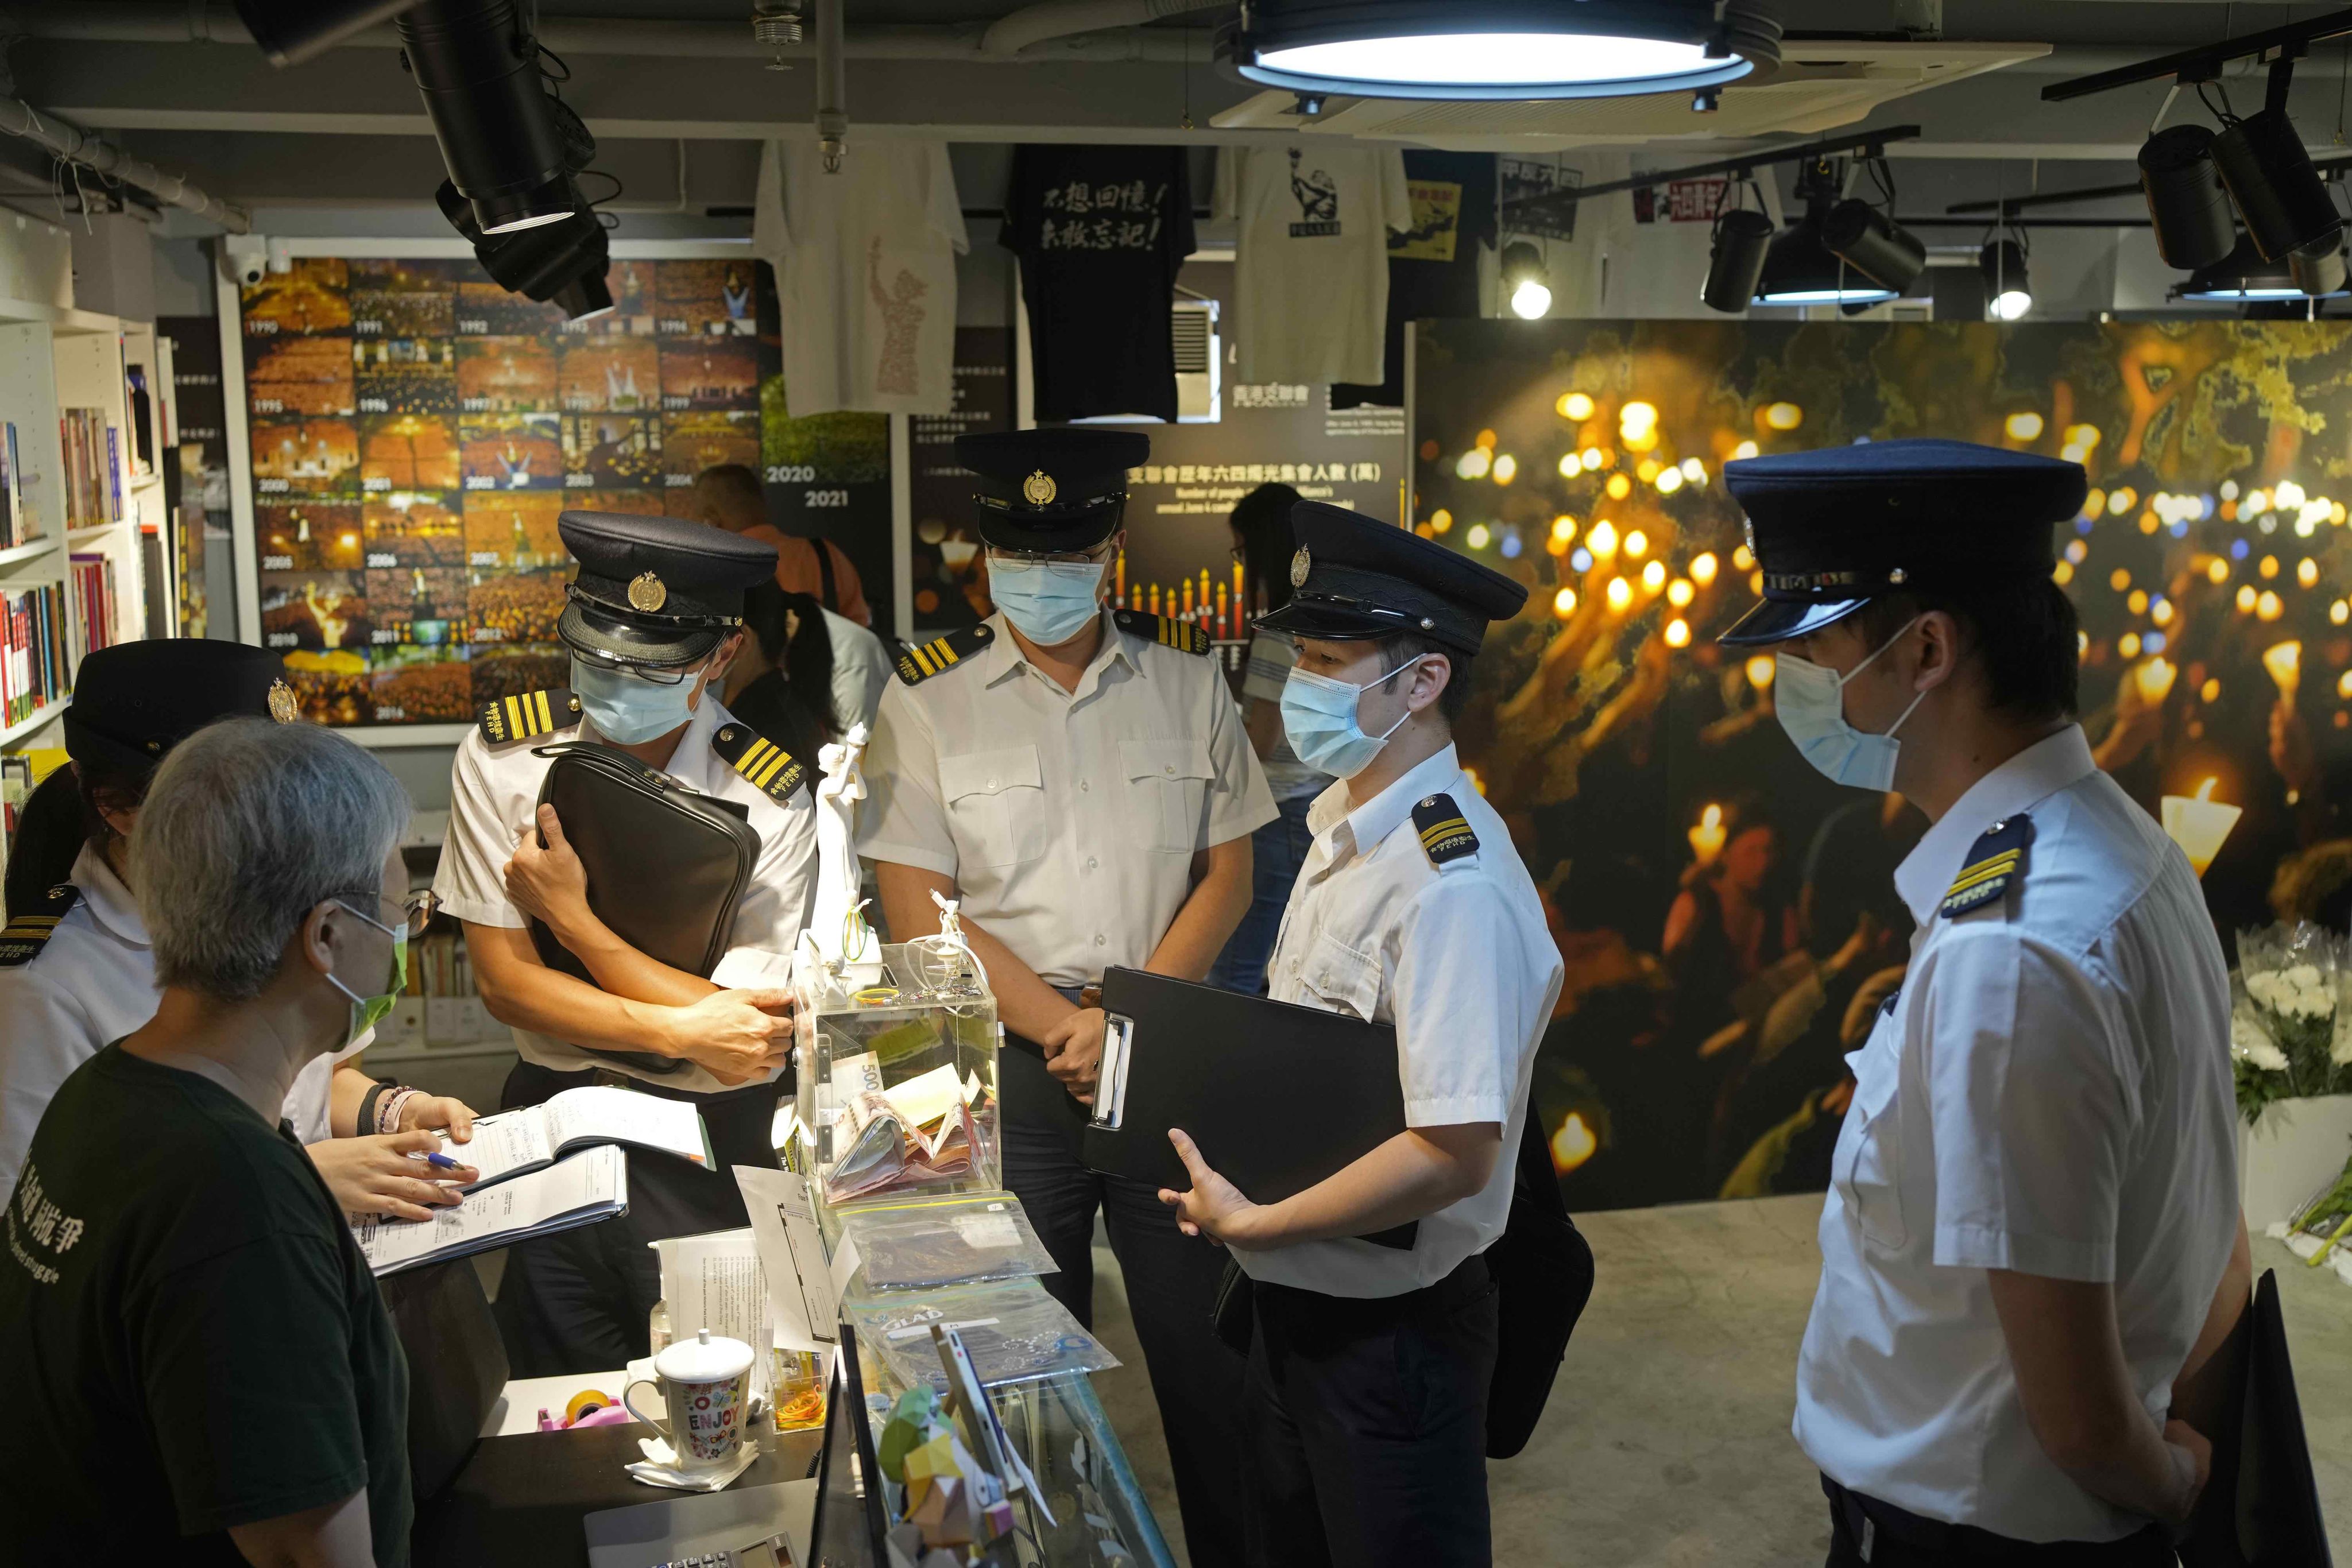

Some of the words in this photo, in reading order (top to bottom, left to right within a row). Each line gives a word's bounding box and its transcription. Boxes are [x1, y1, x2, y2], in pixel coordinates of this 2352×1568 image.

[356, 320, 382, 334] 1991
[767, 466, 815, 483] 2020
[806, 490, 848, 508] 2021
[485, 711, 494, 733] FEHD
[782, 773, 799, 792] FEHD
[1440, 841, 1465, 851] FEHD
[862, 1064, 879, 1090] 500
[880, 1310, 943, 1330] GLAD
[688, 1404, 740, 1430] ENJOY
